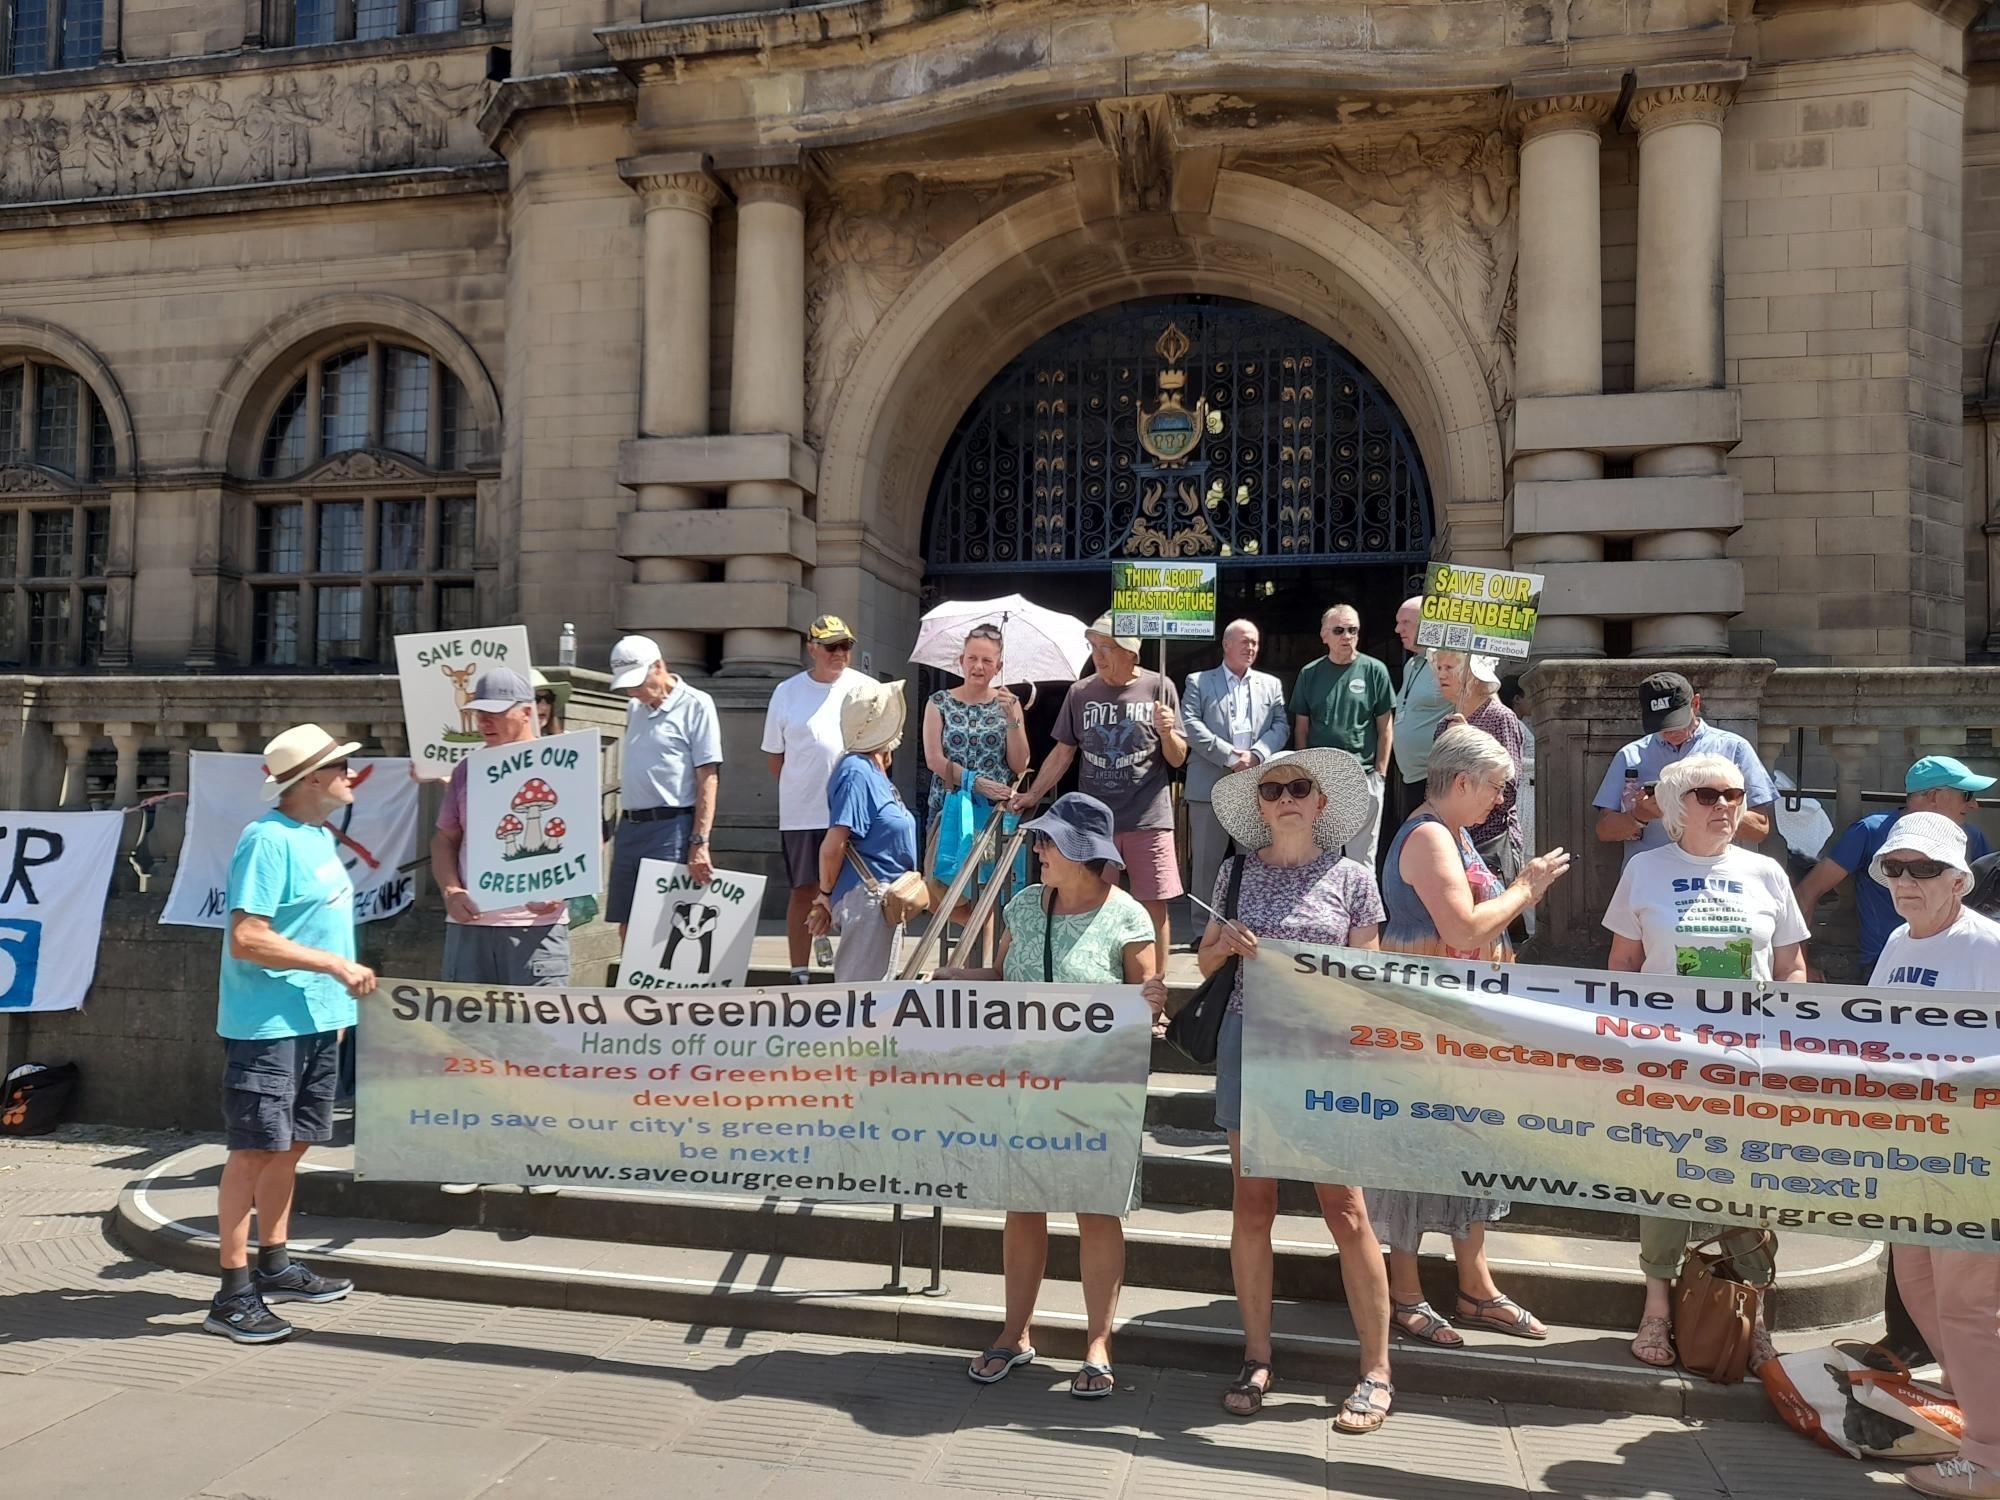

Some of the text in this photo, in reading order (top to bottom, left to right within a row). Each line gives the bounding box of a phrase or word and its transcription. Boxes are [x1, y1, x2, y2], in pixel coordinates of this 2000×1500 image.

[1125, 568, 1203, 588] THINK ABOUT
[1435, 566, 1531, 602] SAVE OUR
[1113, 590, 1214, 611] INFRASTRUCTURE
[1423, 595, 1535, 631] GREENBELT
[417, 639, 508, 667] SAVE OUR
[1490, 644, 1525, 656] Facebook
[1650, 696, 1671, 711] CAT
[487, 747, 578, 783] SAVE OUR
[1096, 770, 1129, 780] AMERICAN
[479, 854, 587, 893] GREENBELT
[655, 874, 745, 904] SAVE OUR
[1672, 878, 1743, 894] SAVE
[1675, 925, 1752, 934] GREENBELT
[1294, 953, 1509, 995] Sheffield
[1575, 979, 1674, 1010] The
[1696, 988, 1821, 1021] UK's
[1841, 997, 2000, 1030] Gree
[391, 985, 1115, 1033] Sheffield Greenbelt Alliance
[582, 1032, 898, 1058] Hands off our Greenbelt
[1595, 1015, 1681, 1043] Not
[1694, 1024, 1766, 1049] for
[443, 1057, 1066, 1091] 235 hectares of Greenbelt planned for
[1350, 1025, 1424, 1051] 235
[1436, 1034, 1624, 1074] hectares
[1637, 1059, 1689, 1080] of
[1700, 1063, 1958, 1103] Greenbelt
[633, 1090, 854, 1111] development
[1616, 1085, 1950, 1135] development
[410, 1109, 1107, 1152] Help save our city's greenbelt or you could
[1305, 1089, 1991, 1177] Help save our city's greenbelt
[680, 1142, 811, 1164] be next!
[526, 1163, 968, 1199] www.saveourgreenbelt.net
[1676, 1158, 1878, 1199] be next!
[1898, 1387, 1966, 1428] oundland
